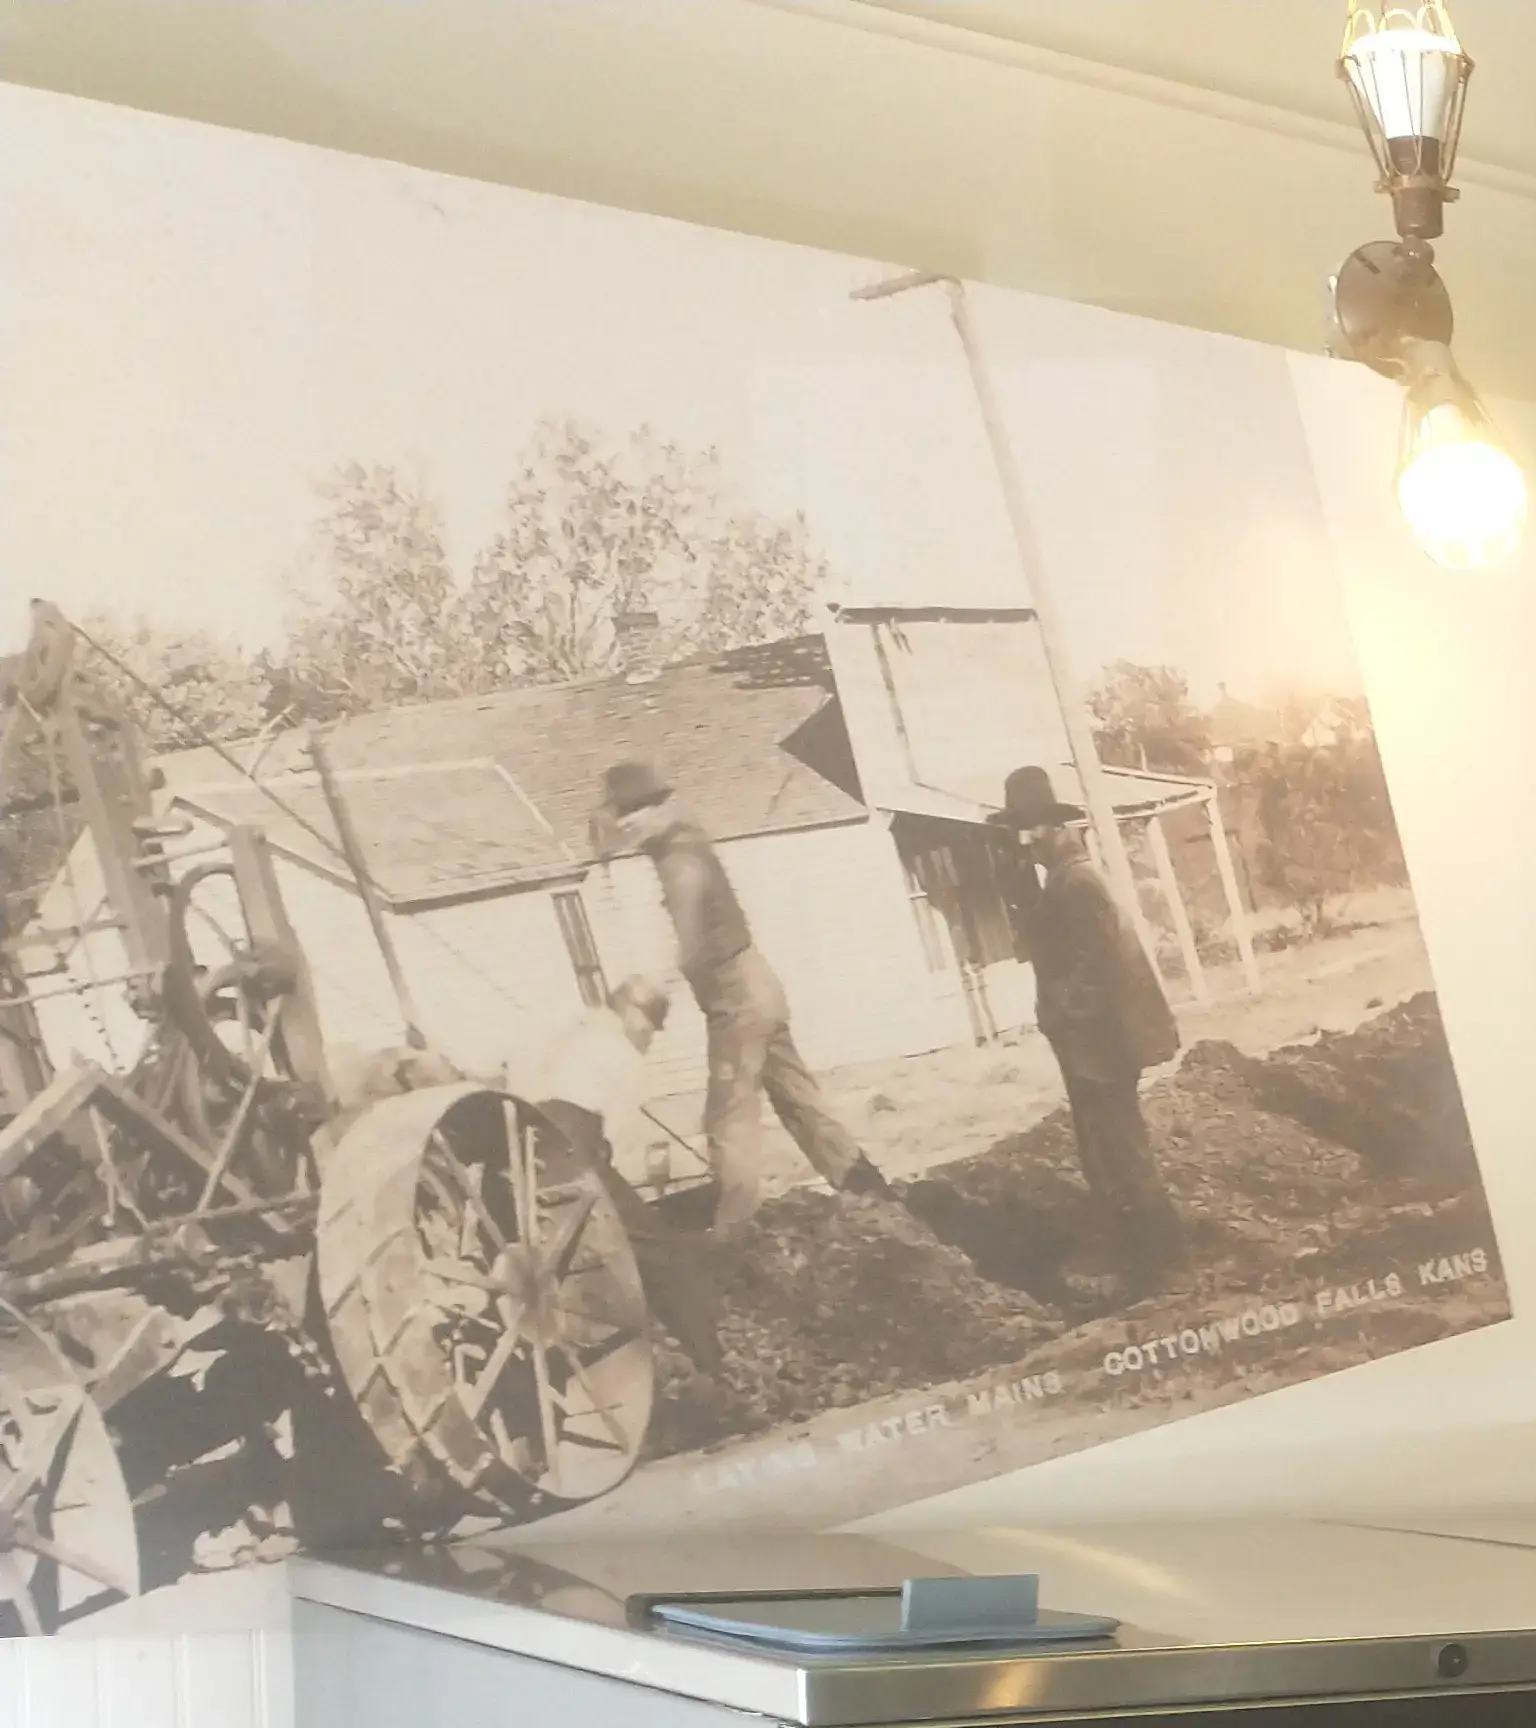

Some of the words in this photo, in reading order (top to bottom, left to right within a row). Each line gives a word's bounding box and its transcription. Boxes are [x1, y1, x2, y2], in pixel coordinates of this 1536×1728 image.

[1103, 1302, 1300, 1377] COTTONWOOD
[1315, 1271, 1403, 1315] FALLS
[1417, 1246, 1489, 1286] KANS
[837, 1402, 953, 1455] WATER
[966, 1370, 1066, 1418] MAINS
